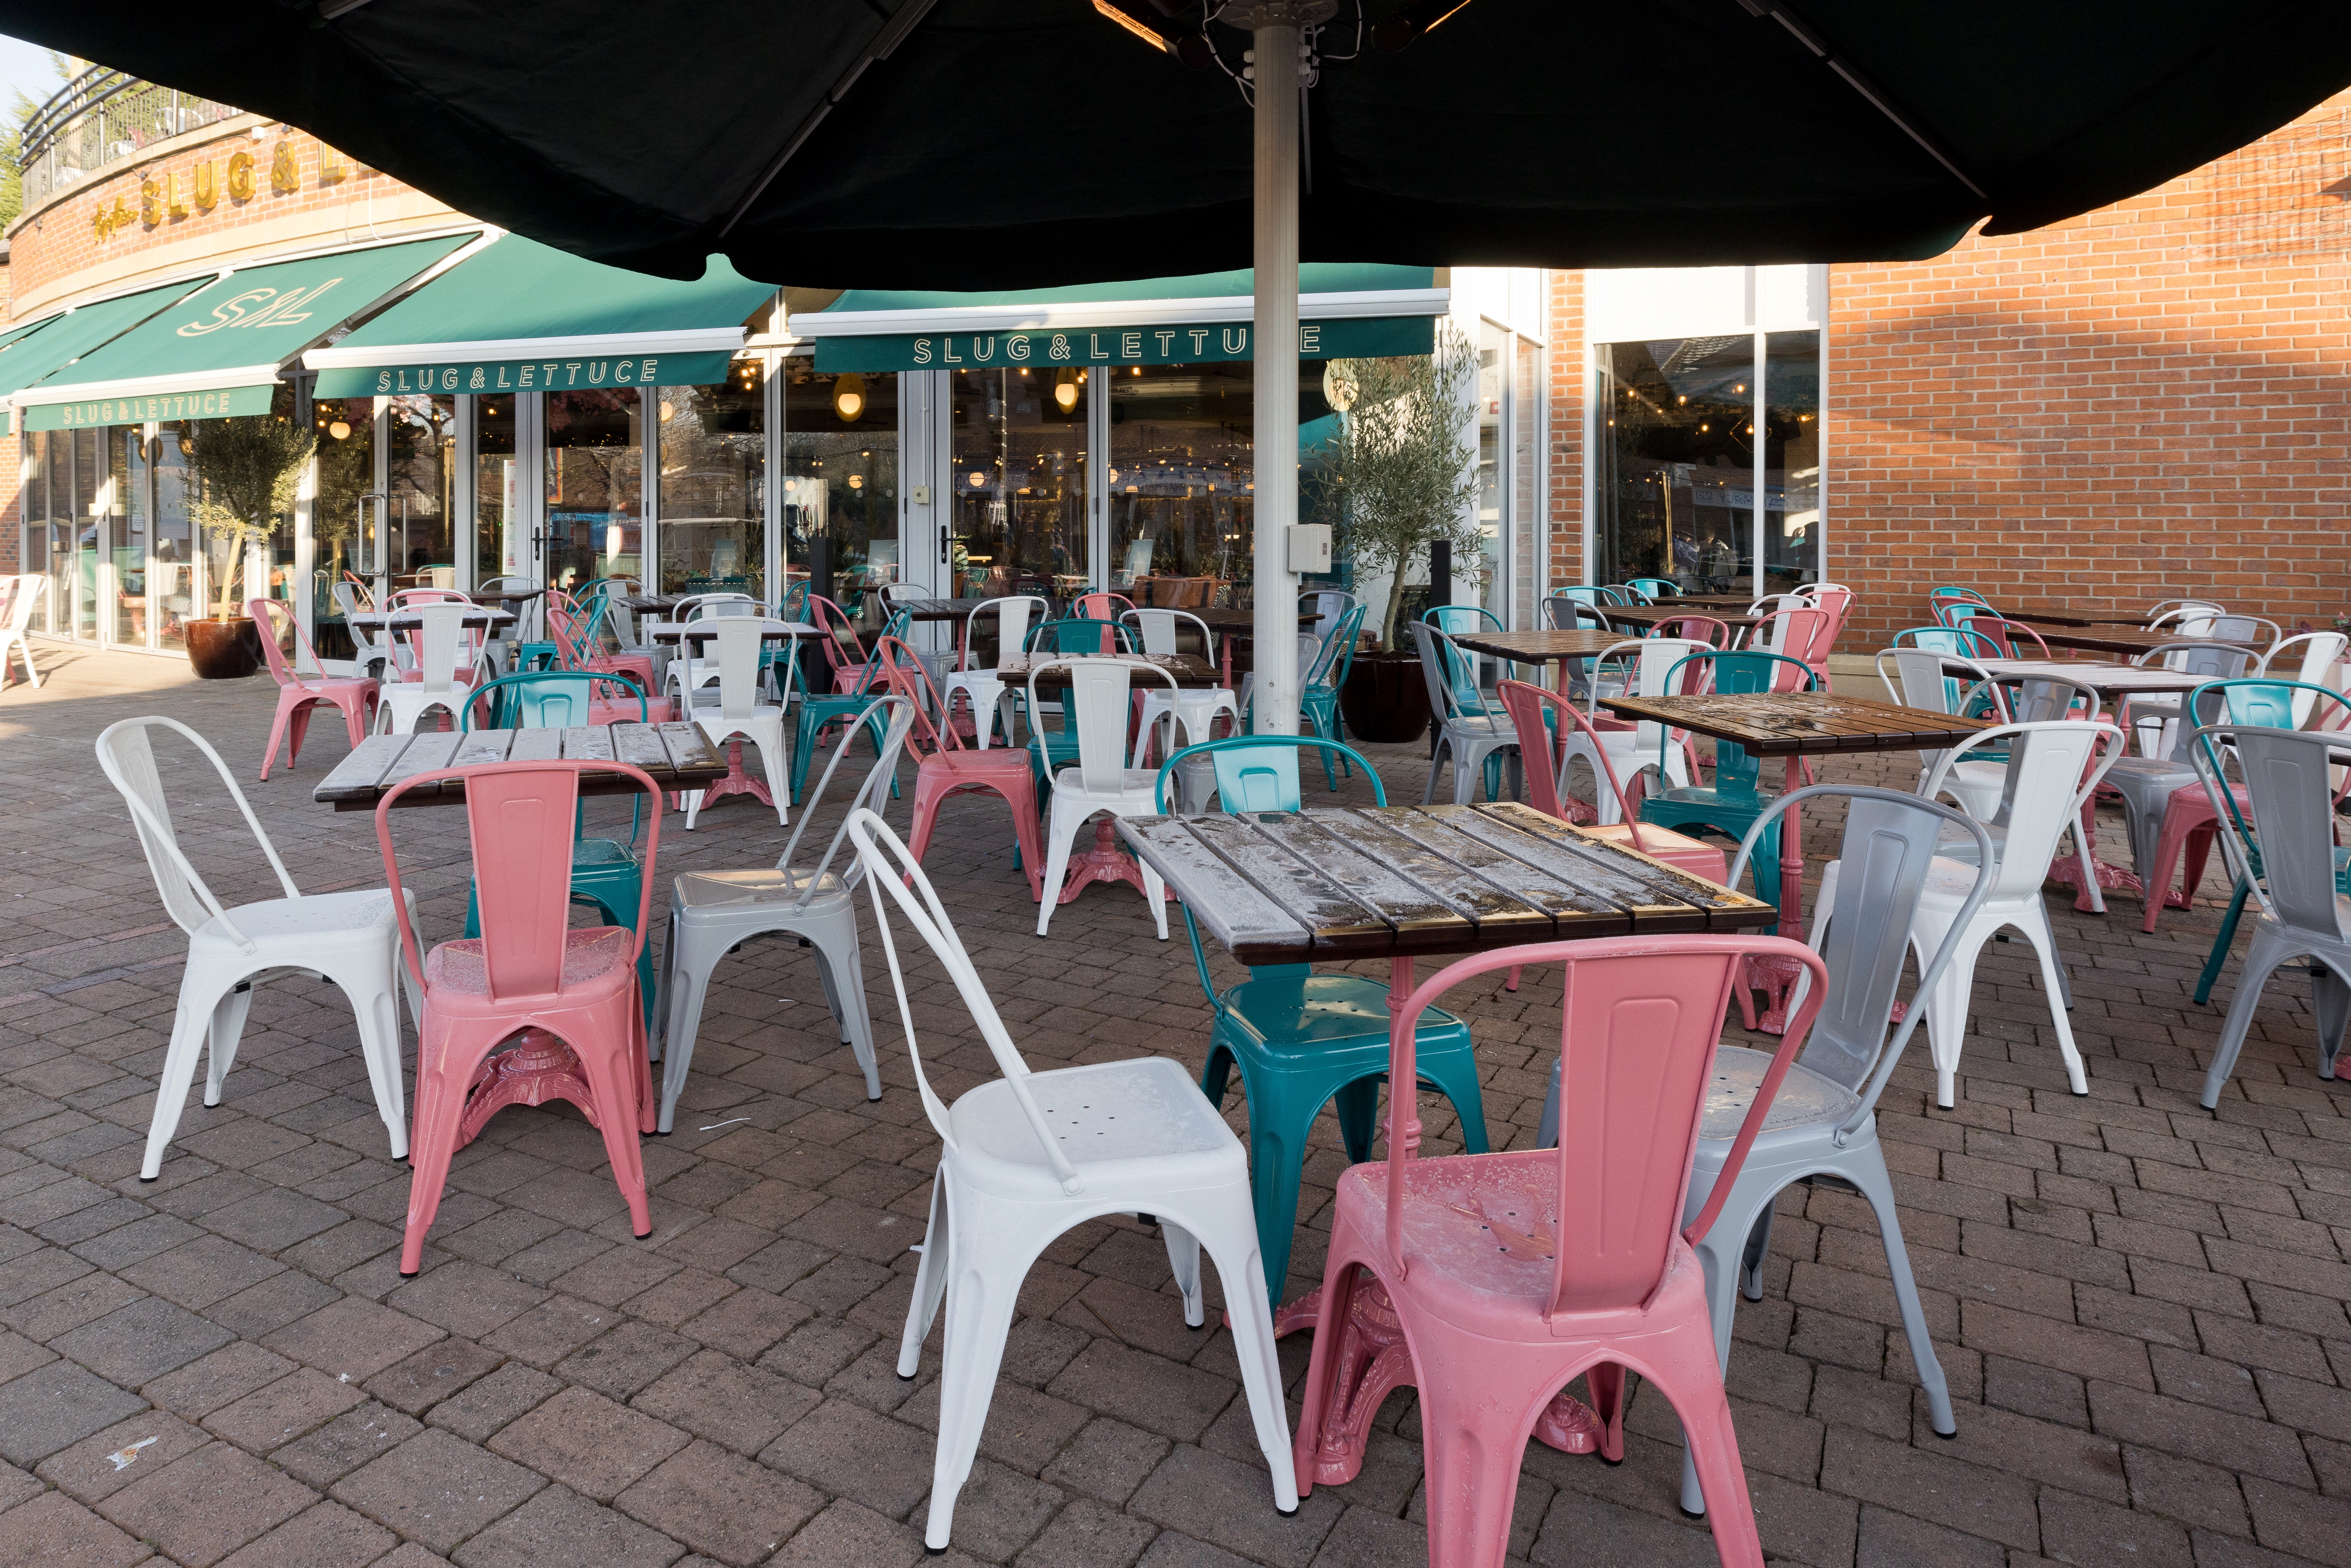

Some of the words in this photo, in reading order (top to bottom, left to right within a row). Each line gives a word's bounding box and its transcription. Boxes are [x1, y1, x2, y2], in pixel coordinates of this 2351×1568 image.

[141, 151, 257, 224] SLUG
[271, 140, 301, 191] &
[913, 335, 1030, 364] SLUG
[1049, 333, 1071, 360] &
[1090, 326, 1321, 359] LETTUE
[377, 368, 458, 392] SLUG
[470, 367, 485, 389] &
[497, 359, 658, 388] LETTUCE
[63, 402, 113, 425] SLUG
[118, 401, 128, 420] &
[135, 393, 230, 419] LETTUCE
